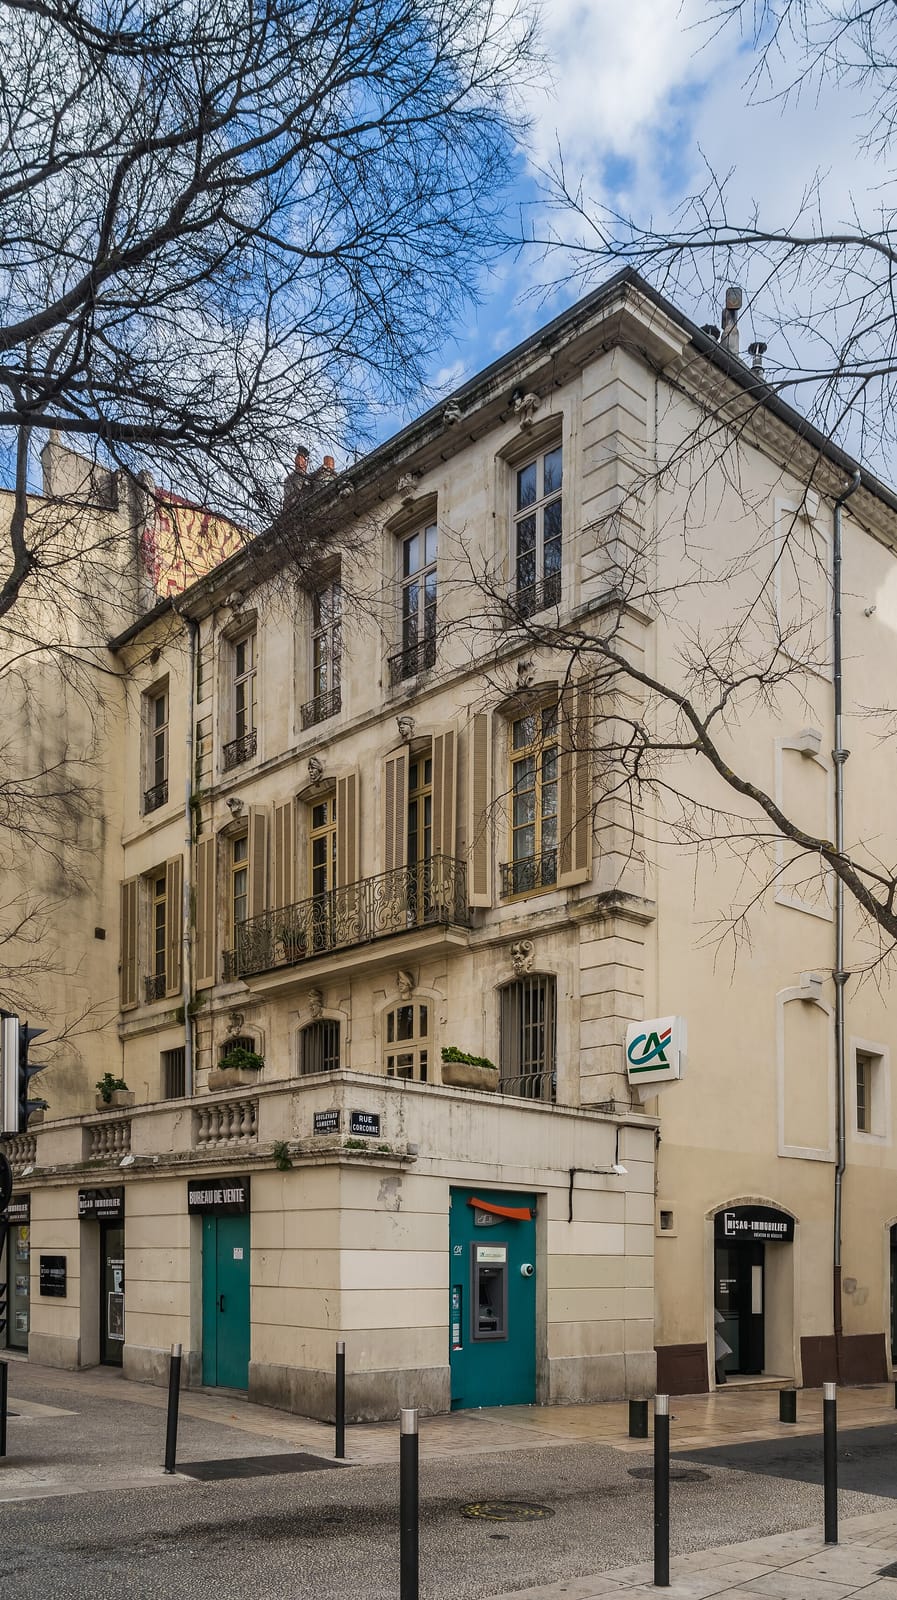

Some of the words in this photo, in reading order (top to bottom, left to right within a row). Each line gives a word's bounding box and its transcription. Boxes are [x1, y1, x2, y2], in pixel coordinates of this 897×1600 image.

[628, 1027, 672, 1065] CA
[359, 1115, 373, 1123] RUE
[189, 1190, 213, 1205] BUREAU
[213, 1189, 223, 1204] DE
[223, 1188, 245, 1203] VENTE
